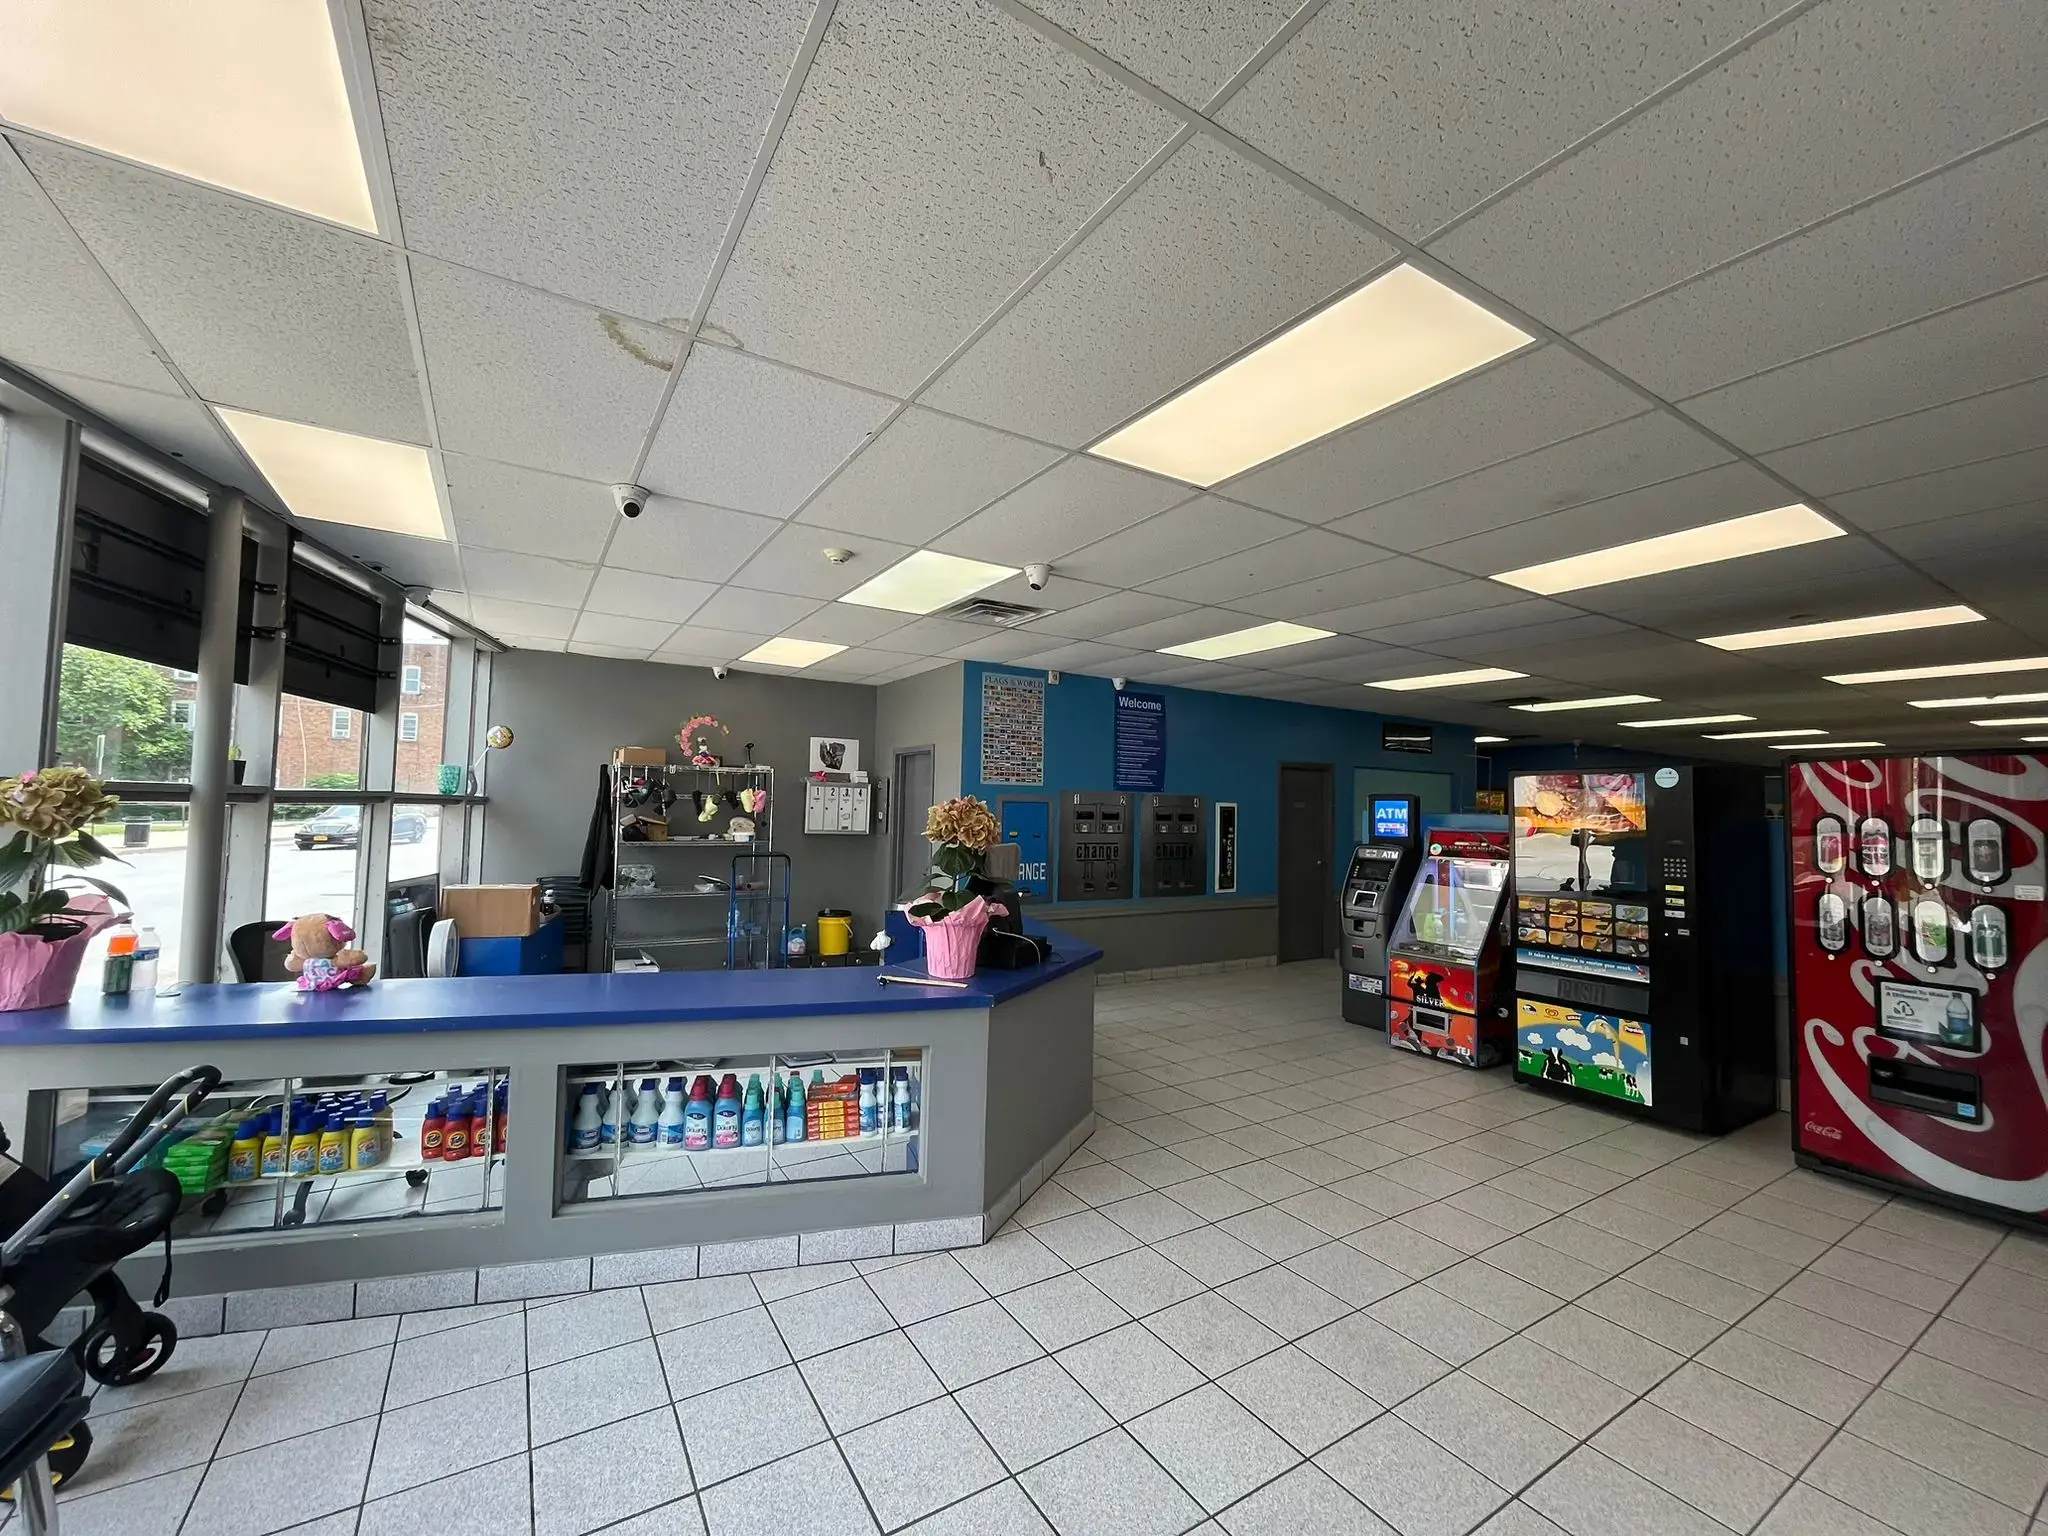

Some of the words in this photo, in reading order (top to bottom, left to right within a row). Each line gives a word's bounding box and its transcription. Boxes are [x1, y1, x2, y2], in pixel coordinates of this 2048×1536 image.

[984, 675, 1009, 685] FLAGS
[1016, 679, 1044, 689] WORLD
[1118, 695, 1162, 711] Welcome
[830, 787, 836, 797] 2
[1376, 808, 1408, 819] ATM
[1076, 843, 1119, 860] change
[1381, 850, 1399, 859] ATM
[1018, 862, 1047, 881] ANGE
[1416, 994, 1446, 1008] SILVER
[686, 1126, 707, 1135] Downy
[716, 1124, 738, 1132] Downy
